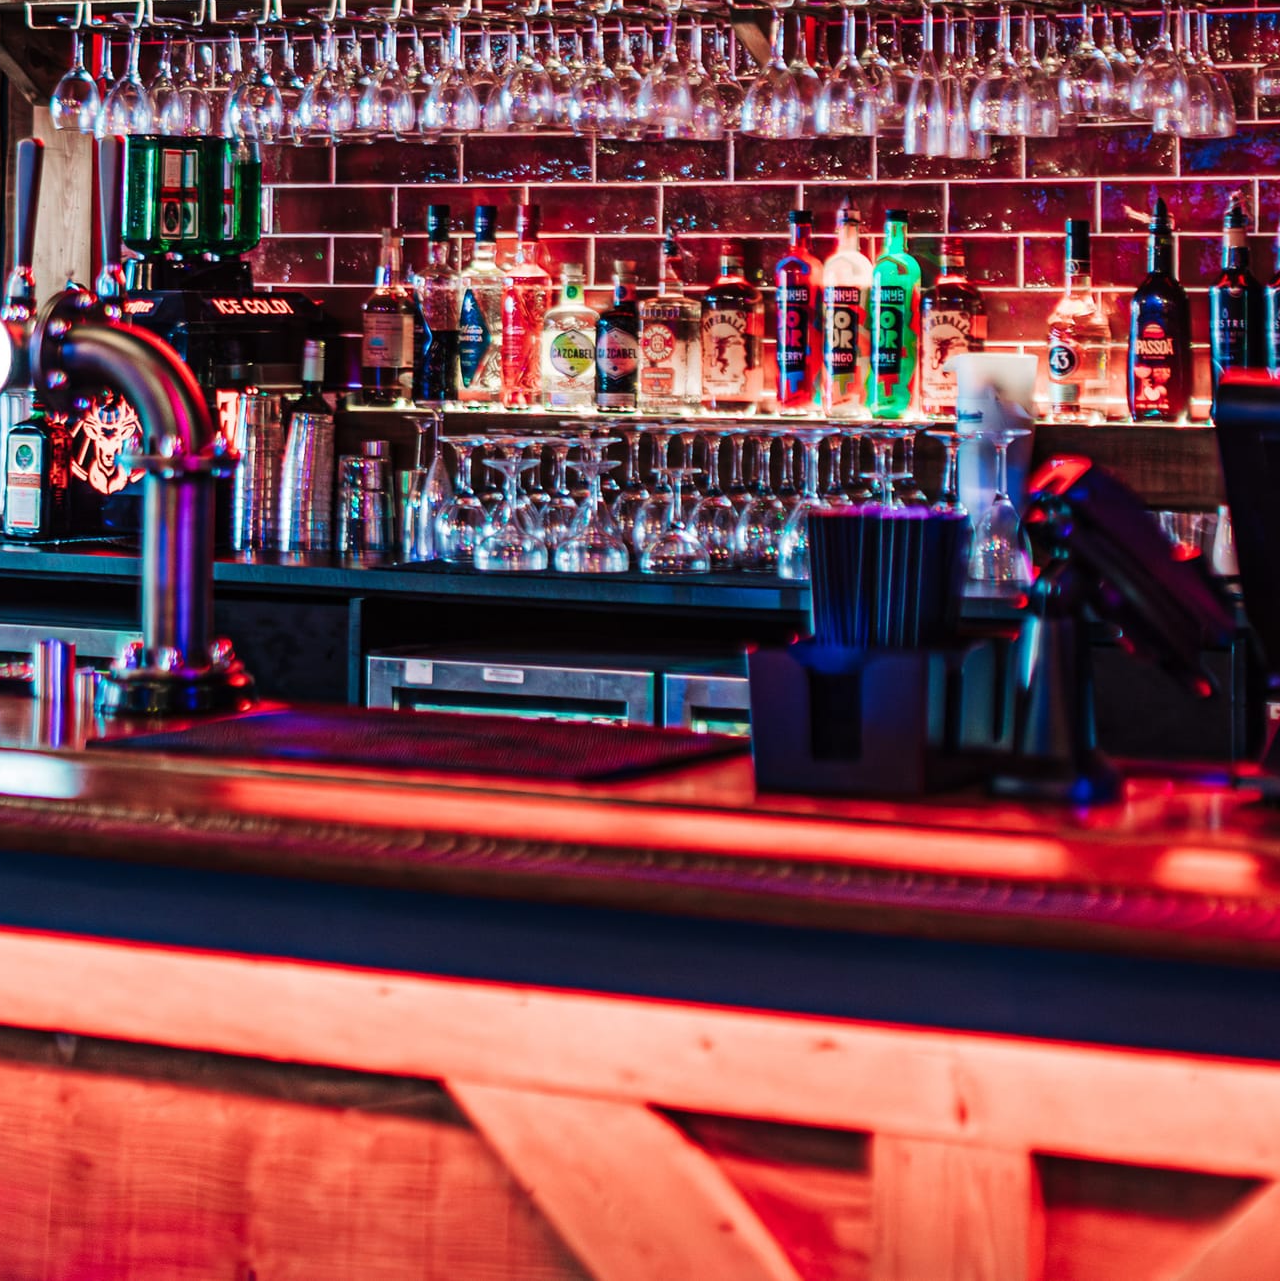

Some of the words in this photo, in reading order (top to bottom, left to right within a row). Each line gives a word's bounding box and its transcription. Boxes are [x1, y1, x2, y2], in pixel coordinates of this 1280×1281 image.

[212, 299, 246, 315] ICE
[242, 299, 295, 315] COLD!
[1050, 350, 1070, 369] 43
